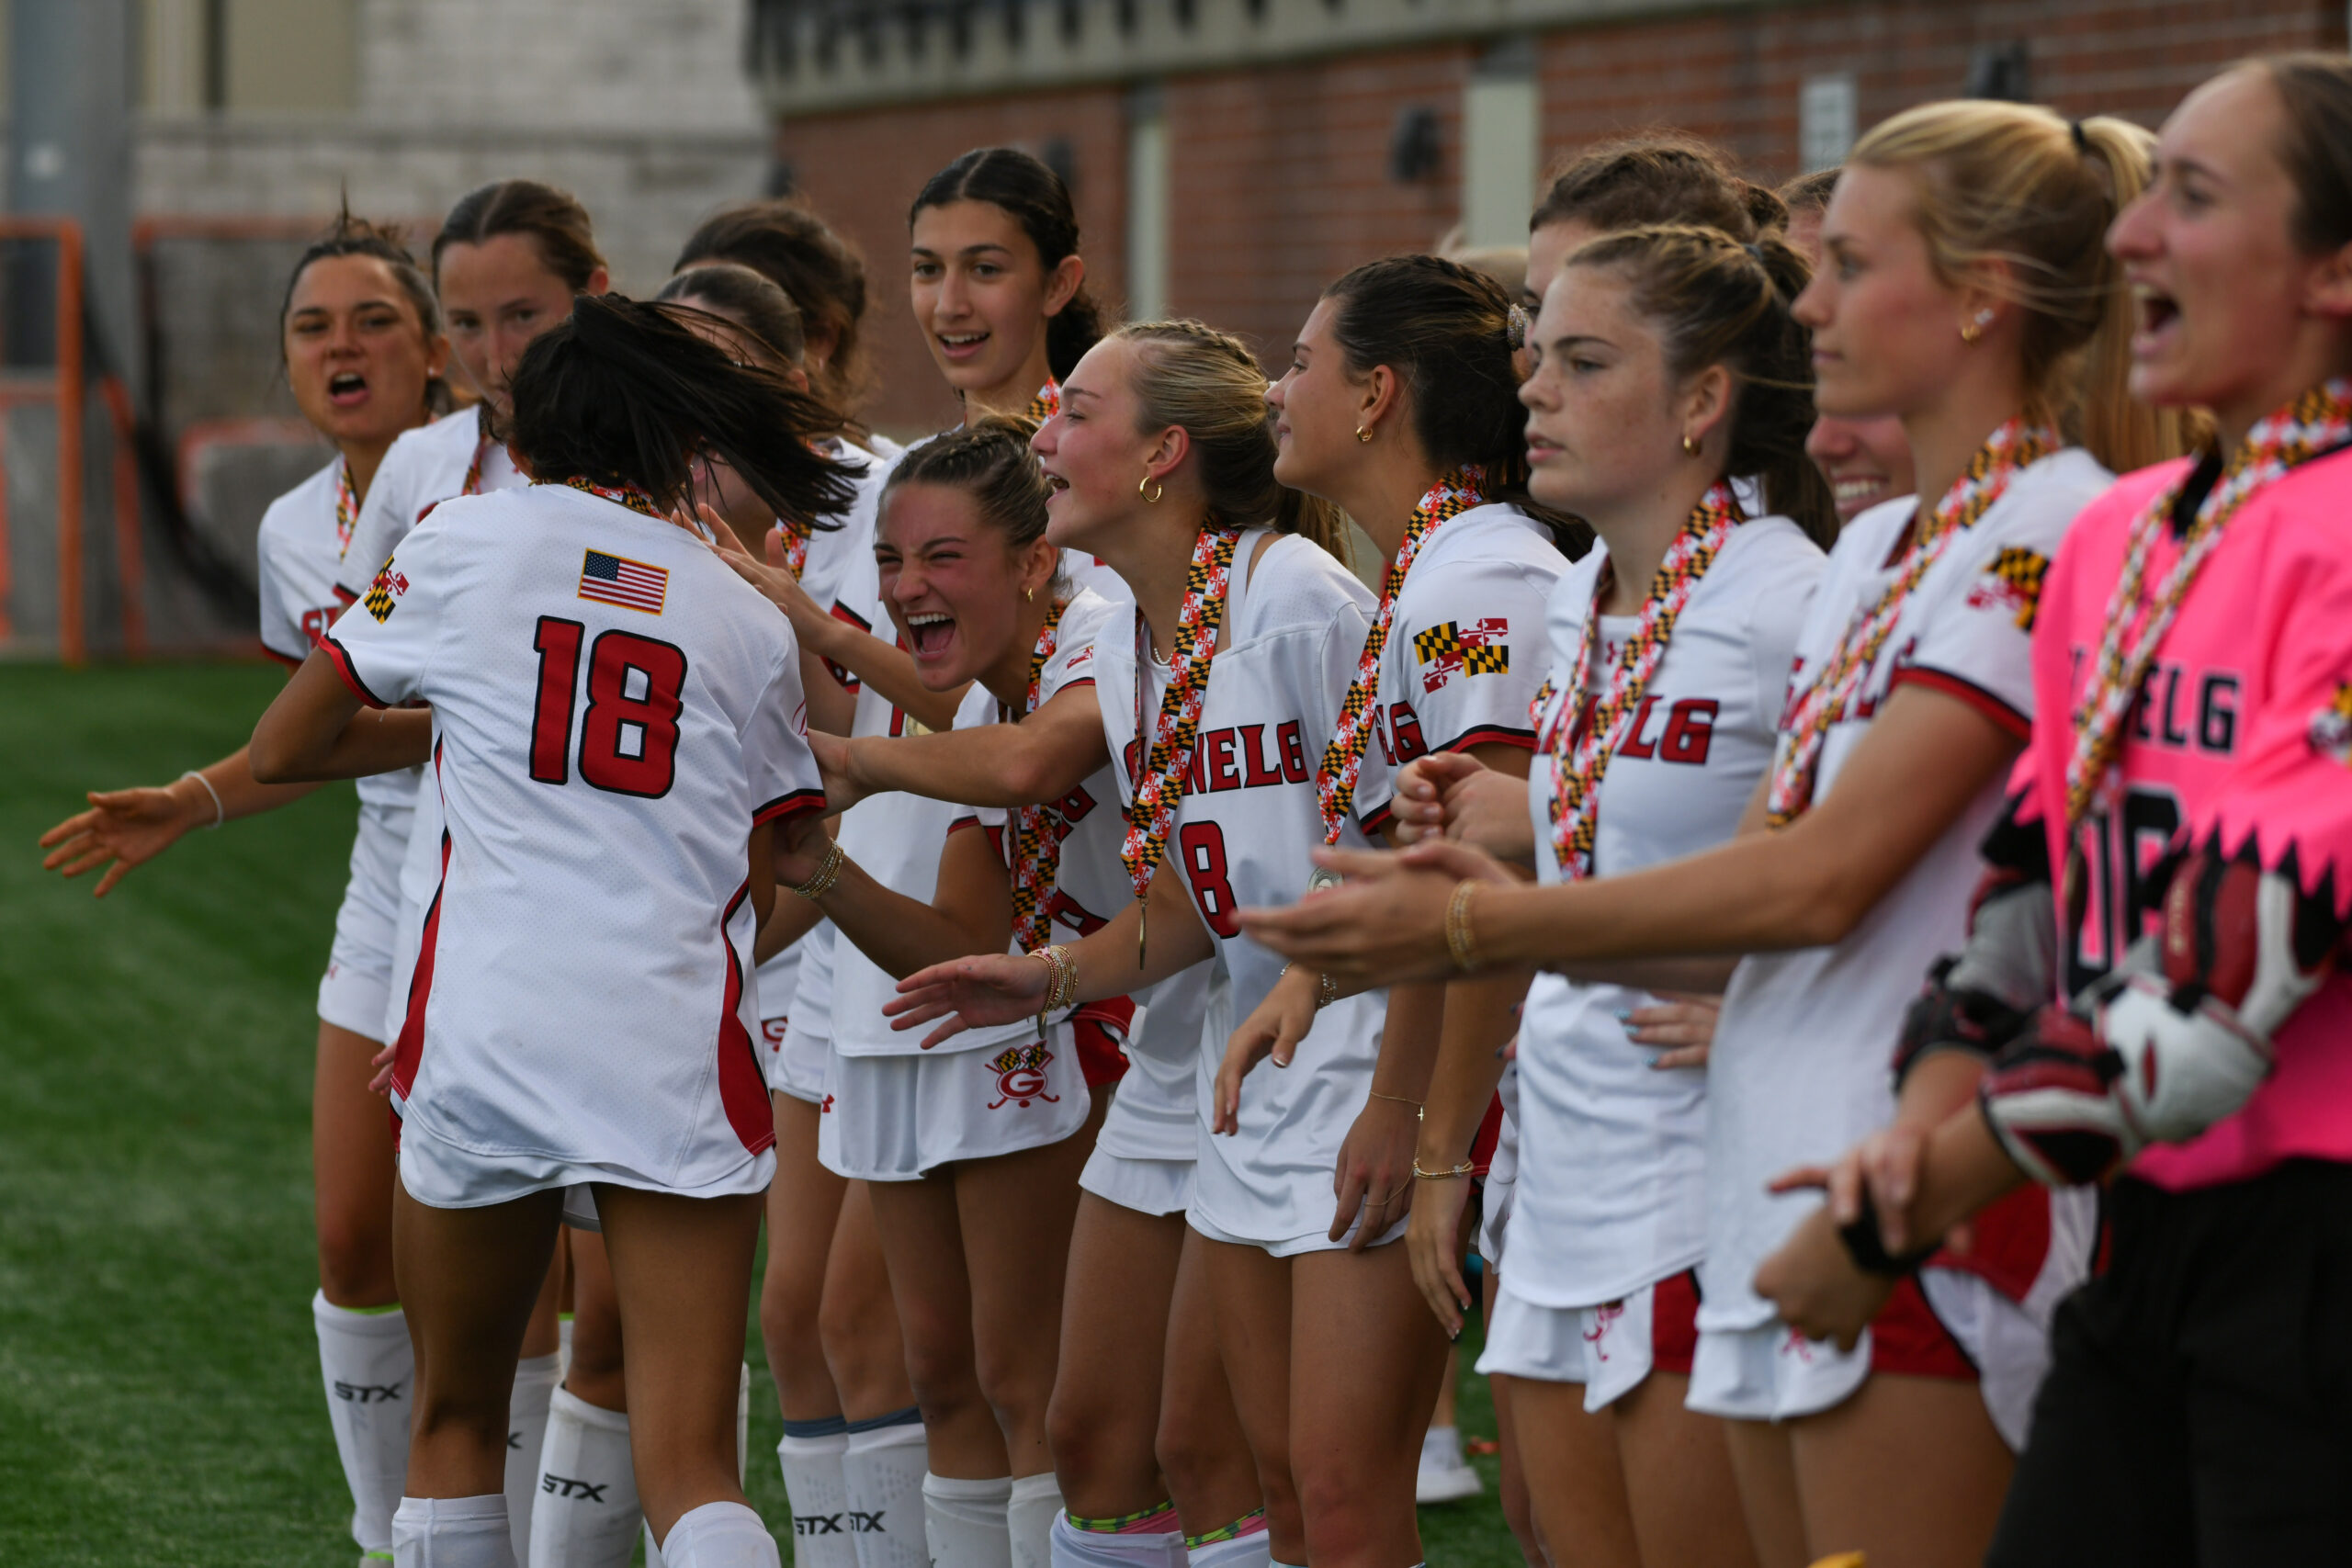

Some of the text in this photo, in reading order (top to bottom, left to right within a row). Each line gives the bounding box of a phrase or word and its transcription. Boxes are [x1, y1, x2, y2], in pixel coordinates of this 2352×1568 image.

[529, 615, 688, 799] 18
[1180, 819, 1242, 939] 8
[334, 1381, 401, 1403] STX
[541, 1472, 609, 1503] STX
[794, 1512, 843, 1536] STX
